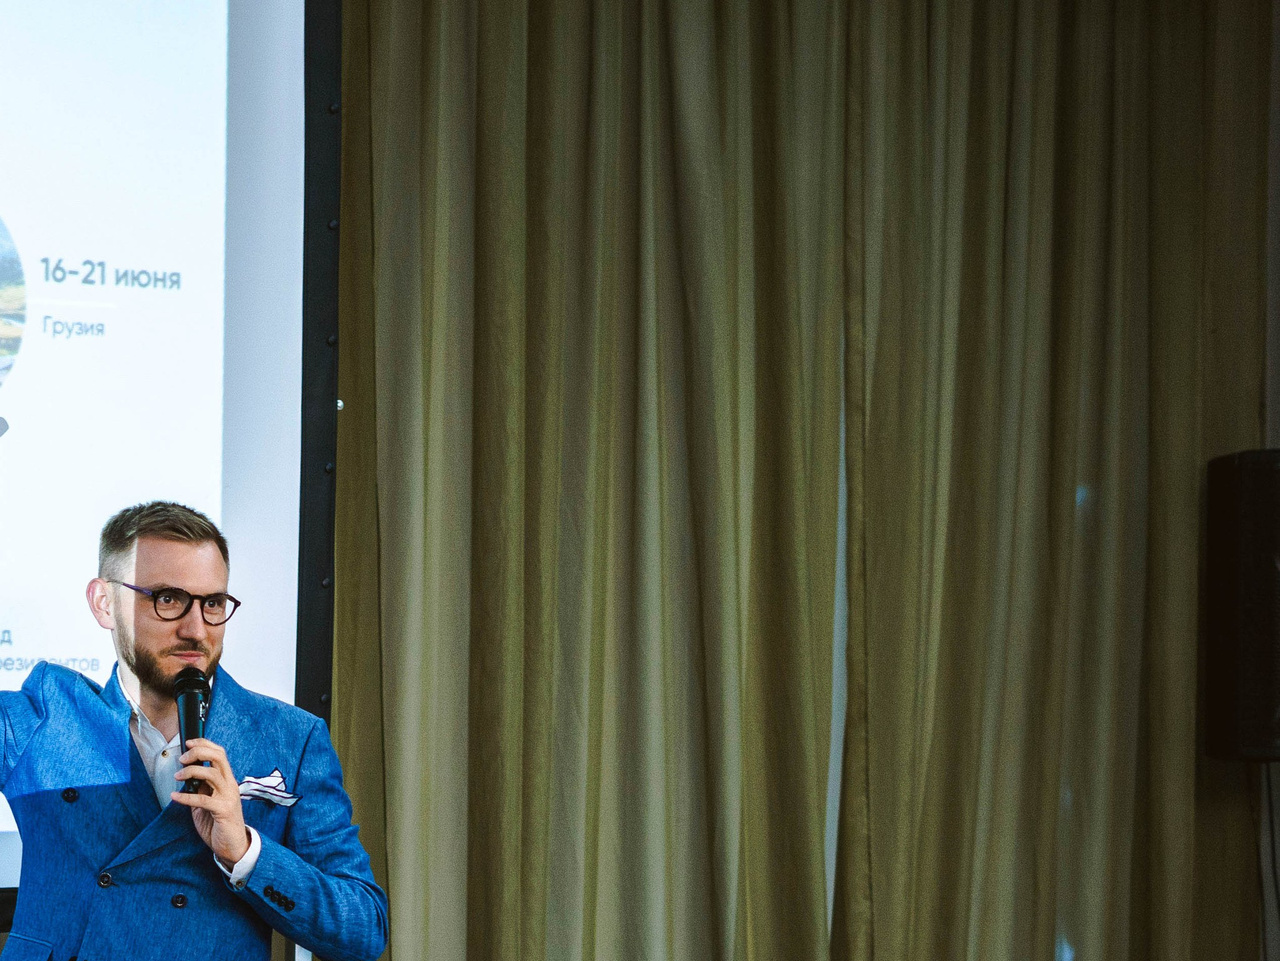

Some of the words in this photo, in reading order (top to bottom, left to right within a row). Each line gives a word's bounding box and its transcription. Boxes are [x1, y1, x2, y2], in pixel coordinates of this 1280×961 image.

[40, 257, 106, 285] 16-21
[114, 268, 181, 290] июня
[43, 315, 106, 339] Грузия
